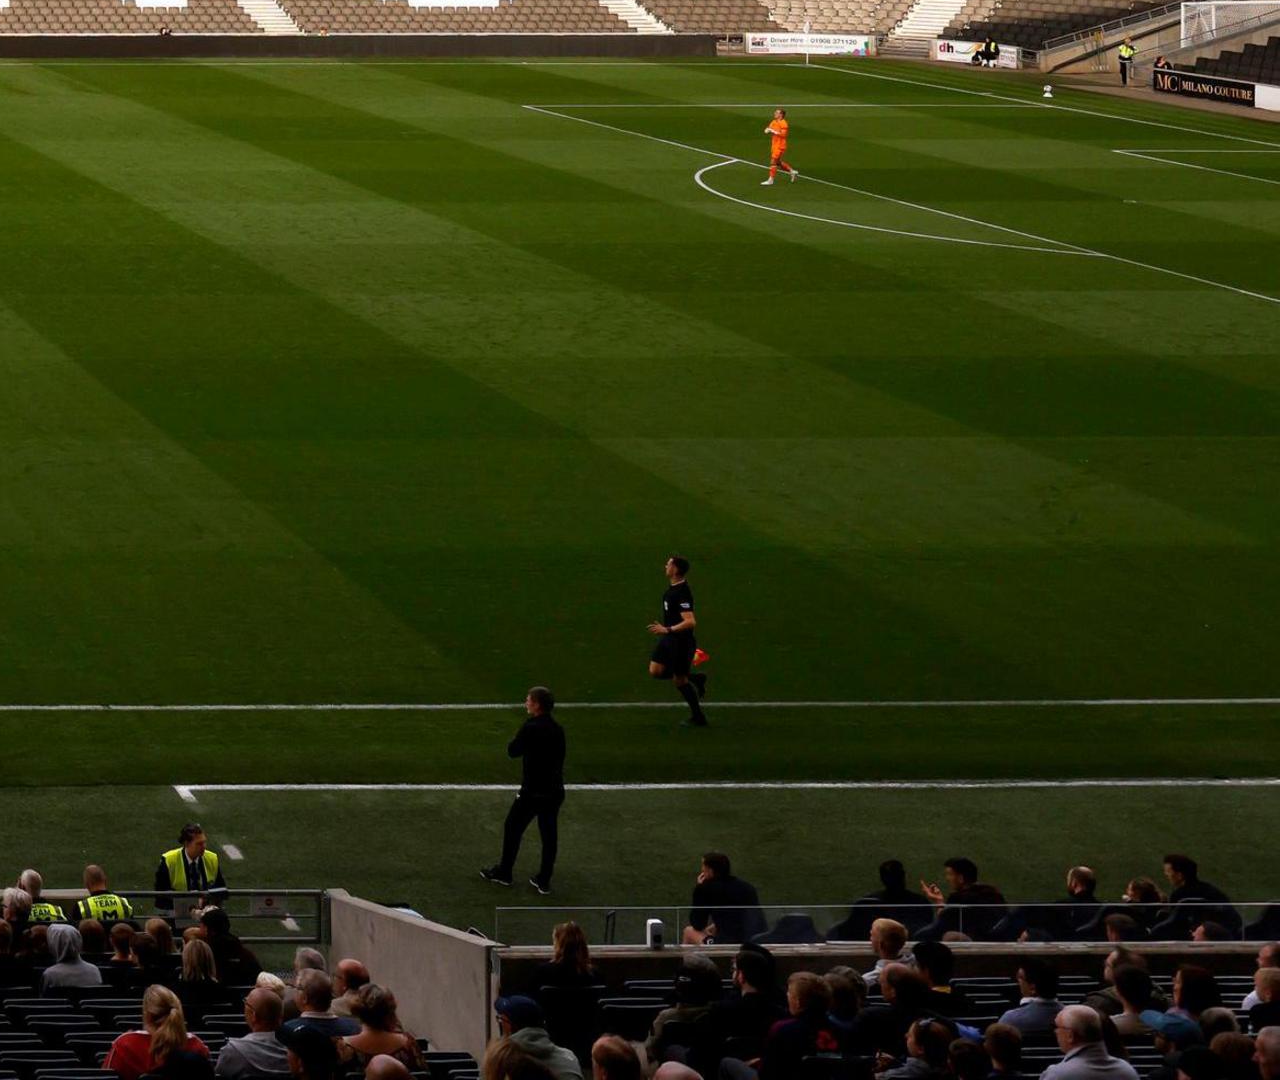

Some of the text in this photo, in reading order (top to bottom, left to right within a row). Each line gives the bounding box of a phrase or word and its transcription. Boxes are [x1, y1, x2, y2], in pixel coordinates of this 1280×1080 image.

[939, 42, 954, 53] dh
[1156, 73, 1253, 101] MC MILANO COUTURE
[94, 899, 118, 908] TEAM
